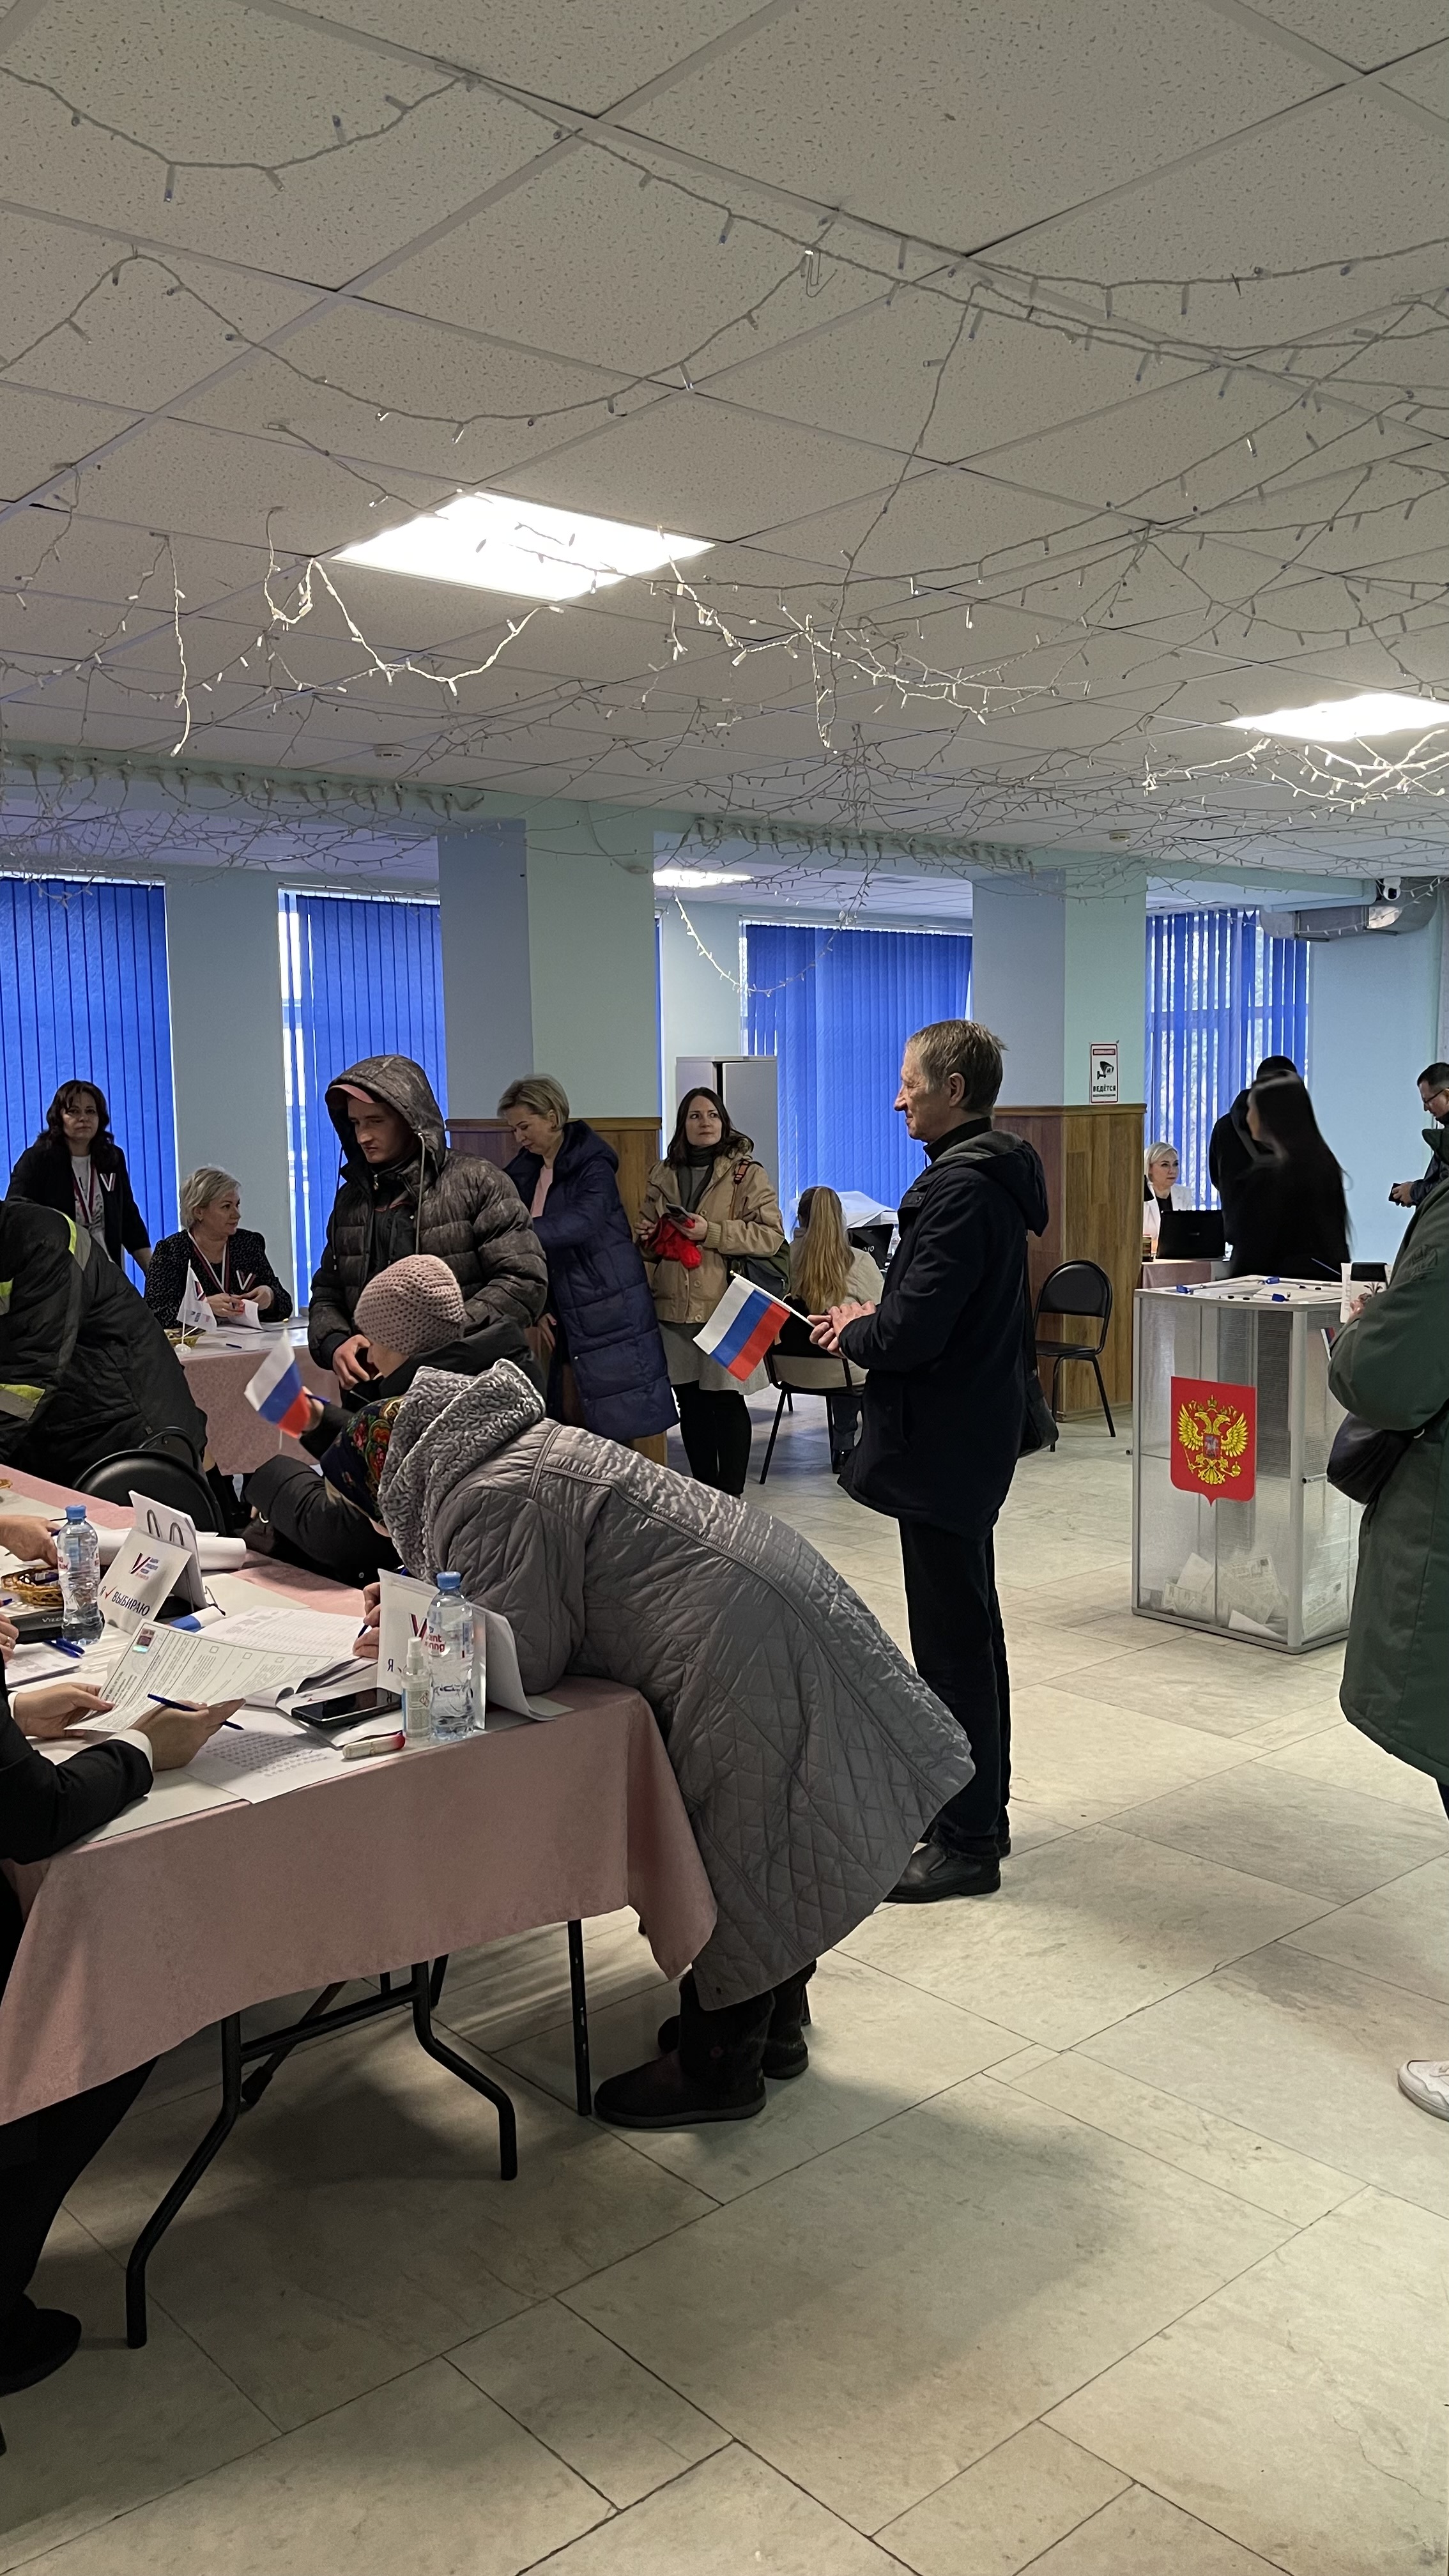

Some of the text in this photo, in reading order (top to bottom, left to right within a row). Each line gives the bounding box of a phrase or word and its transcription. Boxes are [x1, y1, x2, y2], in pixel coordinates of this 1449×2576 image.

[1092, 1084, 1116, 1092] ВЕДЁТСЯ
[111, 1591, 151, 1616] ВЫБИРАЮ
[387, 1658, 394, 1672] Я
